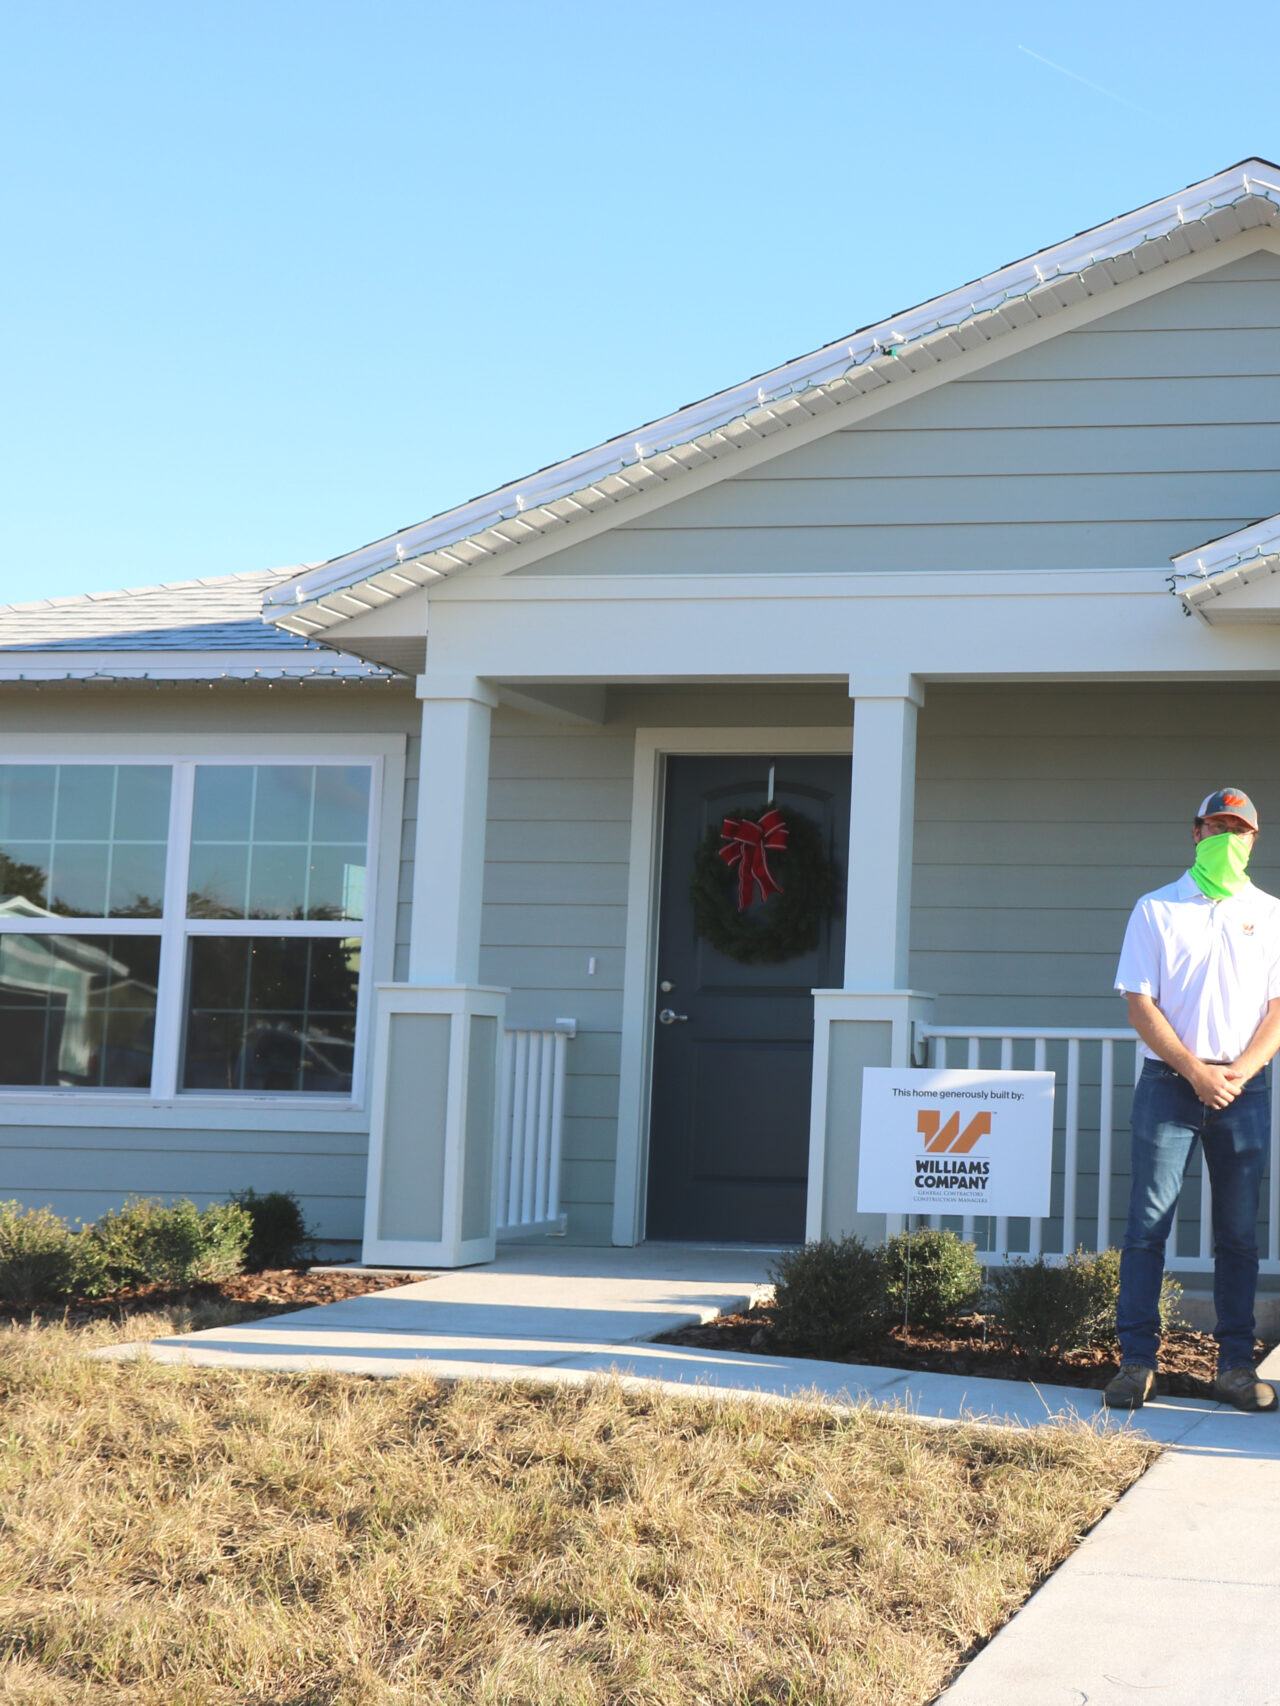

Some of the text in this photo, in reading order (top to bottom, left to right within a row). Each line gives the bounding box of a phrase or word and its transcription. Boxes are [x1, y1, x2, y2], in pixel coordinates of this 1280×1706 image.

[892, 1088, 1025, 1101] This home generously built by:
[915, 1159, 990, 1175] WILLIAMS
[914, 1174, 989, 1190] COMPANY
